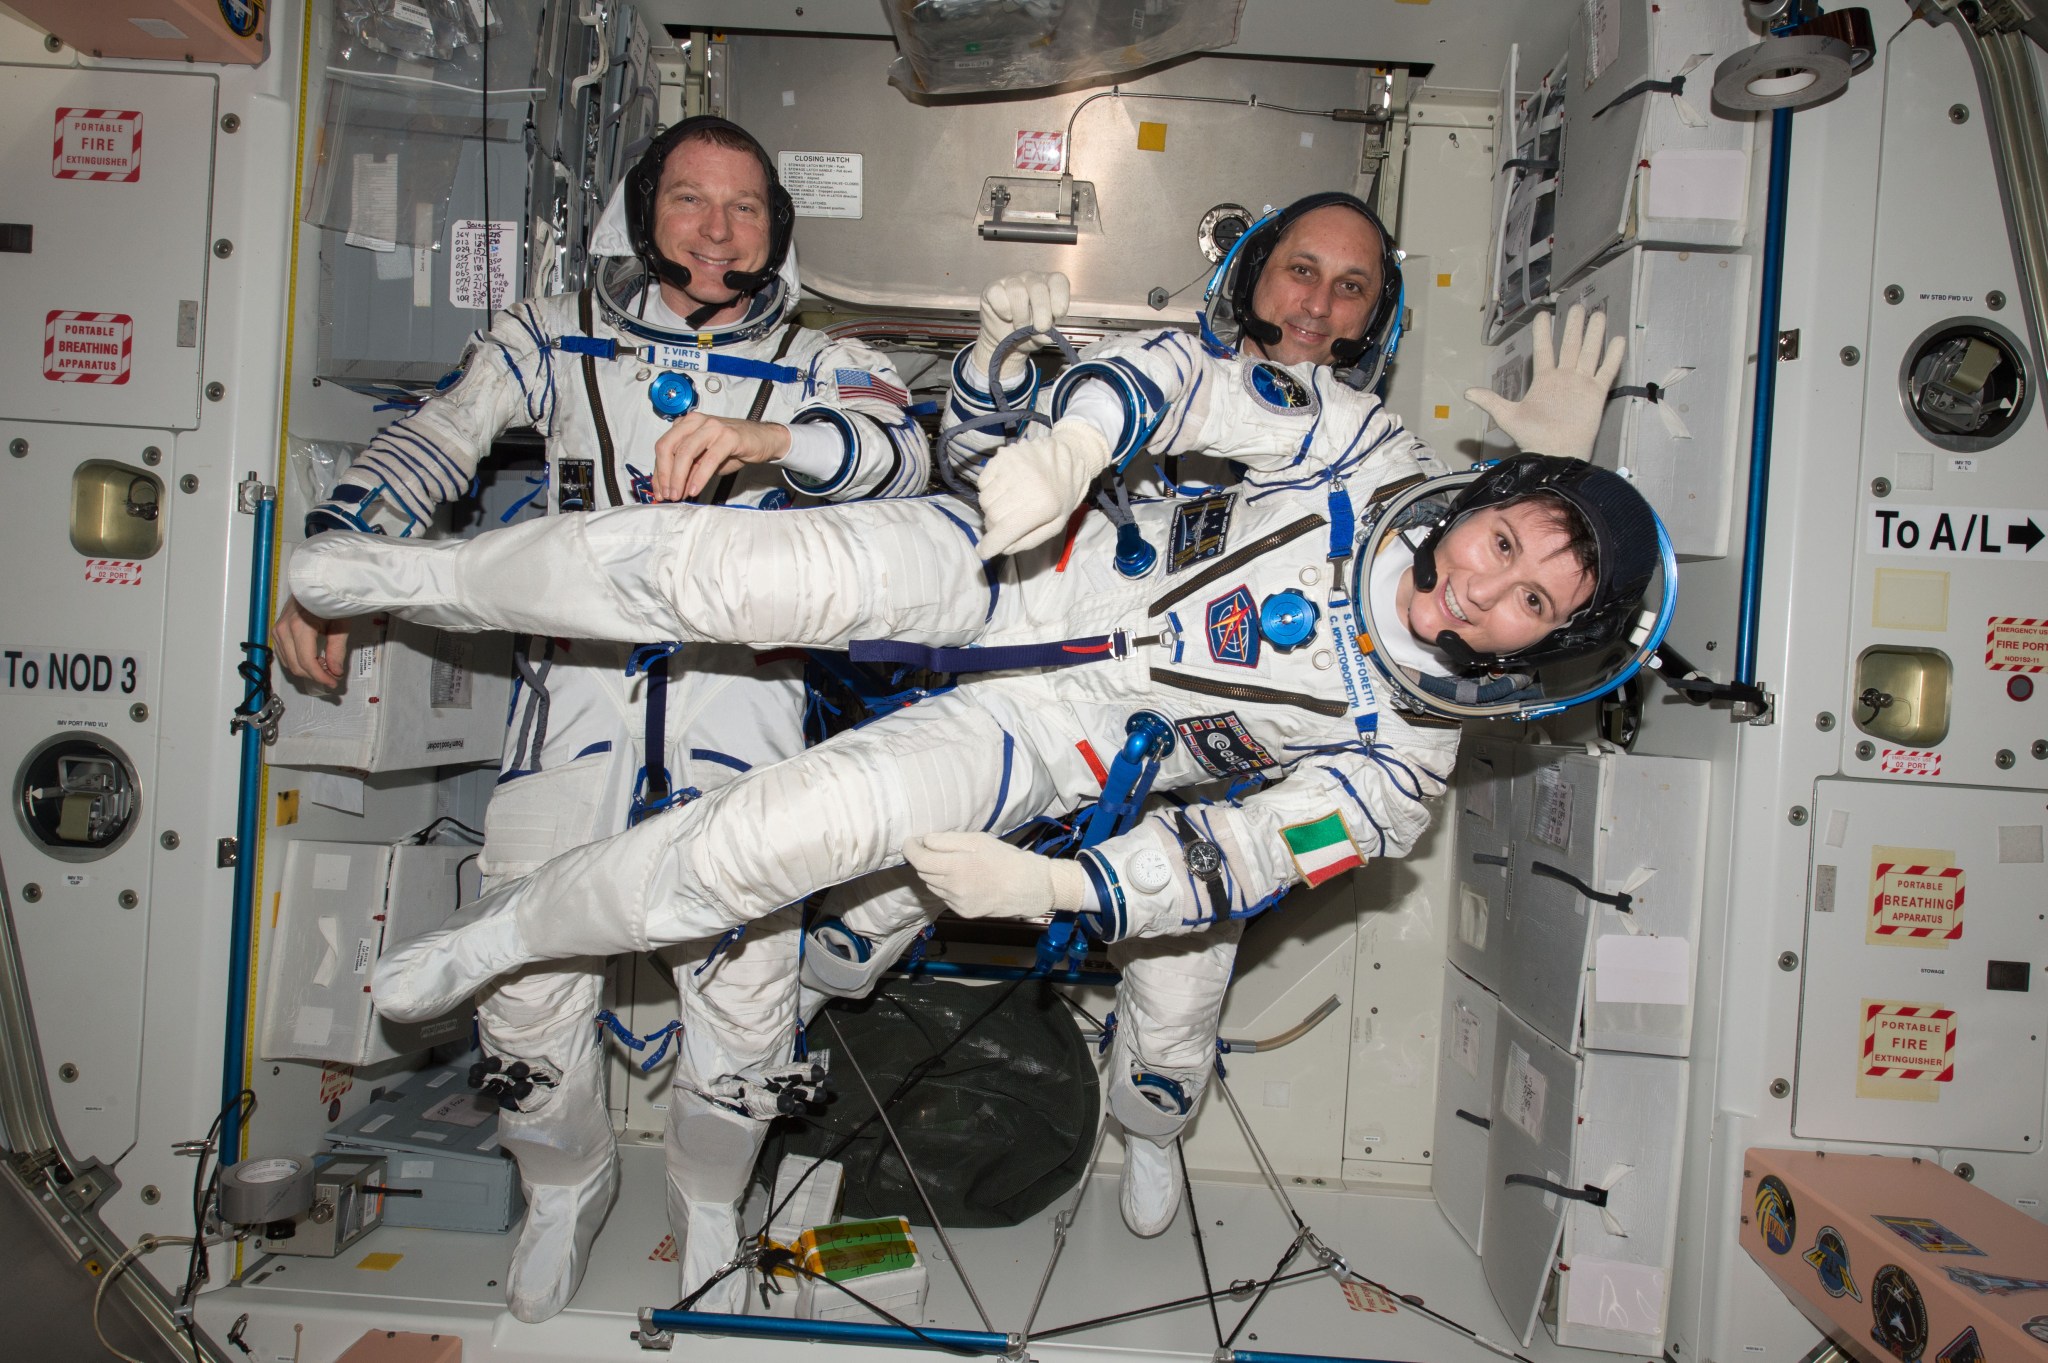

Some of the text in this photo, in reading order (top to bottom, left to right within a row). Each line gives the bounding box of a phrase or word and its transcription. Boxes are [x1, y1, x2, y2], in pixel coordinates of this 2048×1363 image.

[74, 122, 123, 132] PORTABLE
[81, 137, 114, 151] FIRE
[1023, 140, 1055, 161] EXI
[66, 155, 128, 166] EXTINGUISHER
[65, 325, 114, 336] PORTABLE
[59, 341, 118, 355] BREATHING
[664, 346, 701, 358] T. VIRTS
[58, 359, 116, 370] APPARATUS
[1876, 510, 2001, 553] To A/L
[1996, 626, 2037, 634] EMERGENCY
[1996, 640, 2019, 650] FIRE
[1343, 613, 1376, 706] S. CRISTOFORETTI
[4, 651, 136, 694] To NOD 3
[1332, 626, 1360, 709] КРИСТОФОРЕТТИ
[1897, 880, 1943, 890] PORTABLE
[1884, 895, 1954, 910] BREATHING
[1892, 912, 1943, 924] APPARATUS
[1882, 1021, 1941, 1033] PORTABLE
[1892, 1038, 1928, 1050] FIRE
[1874, 1054, 1943, 1066] EXTINGUISHER
